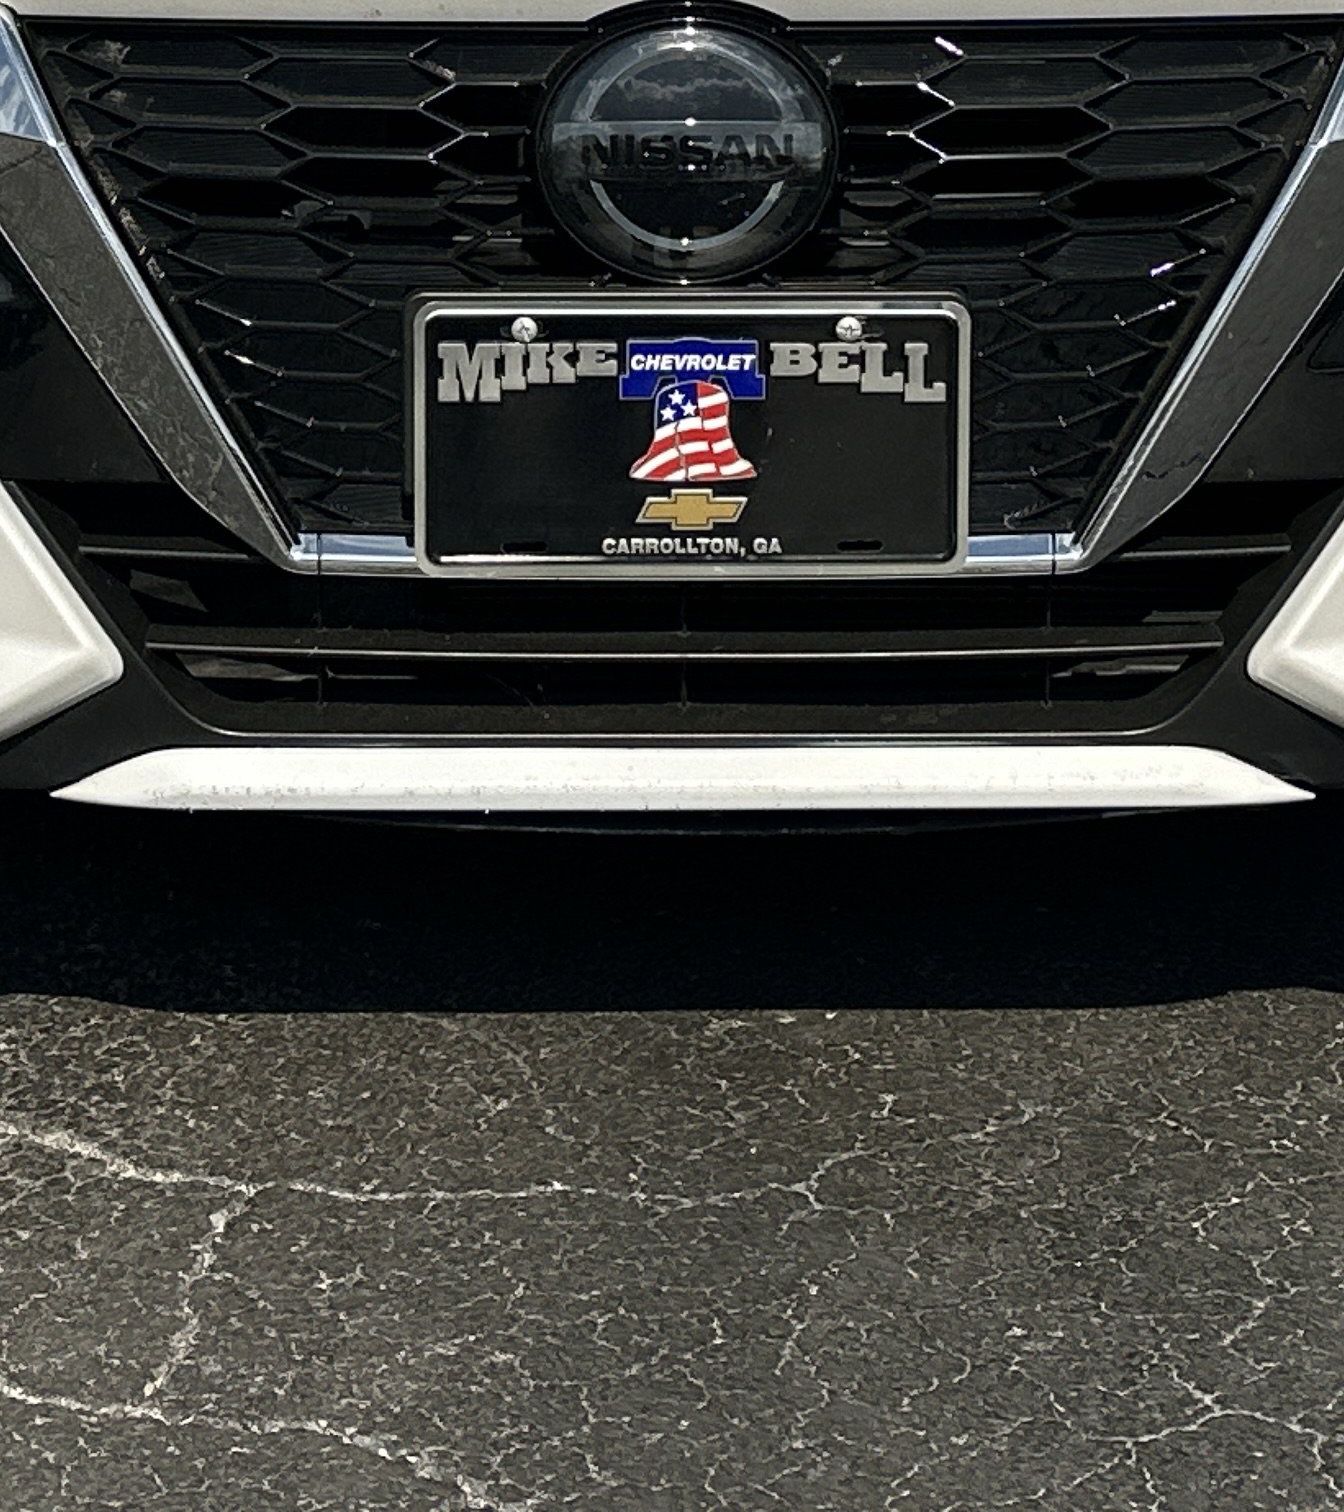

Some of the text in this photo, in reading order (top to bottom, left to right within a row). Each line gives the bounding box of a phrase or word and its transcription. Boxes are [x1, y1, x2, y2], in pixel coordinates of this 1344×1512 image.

[580, 133, 795, 168] NISSAN
[436, 341, 947, 403] MIKE BELL
[629, 353, 757, 372] CHEVROLET
[601, 538, 783, 557] CARROLLTON, GA
